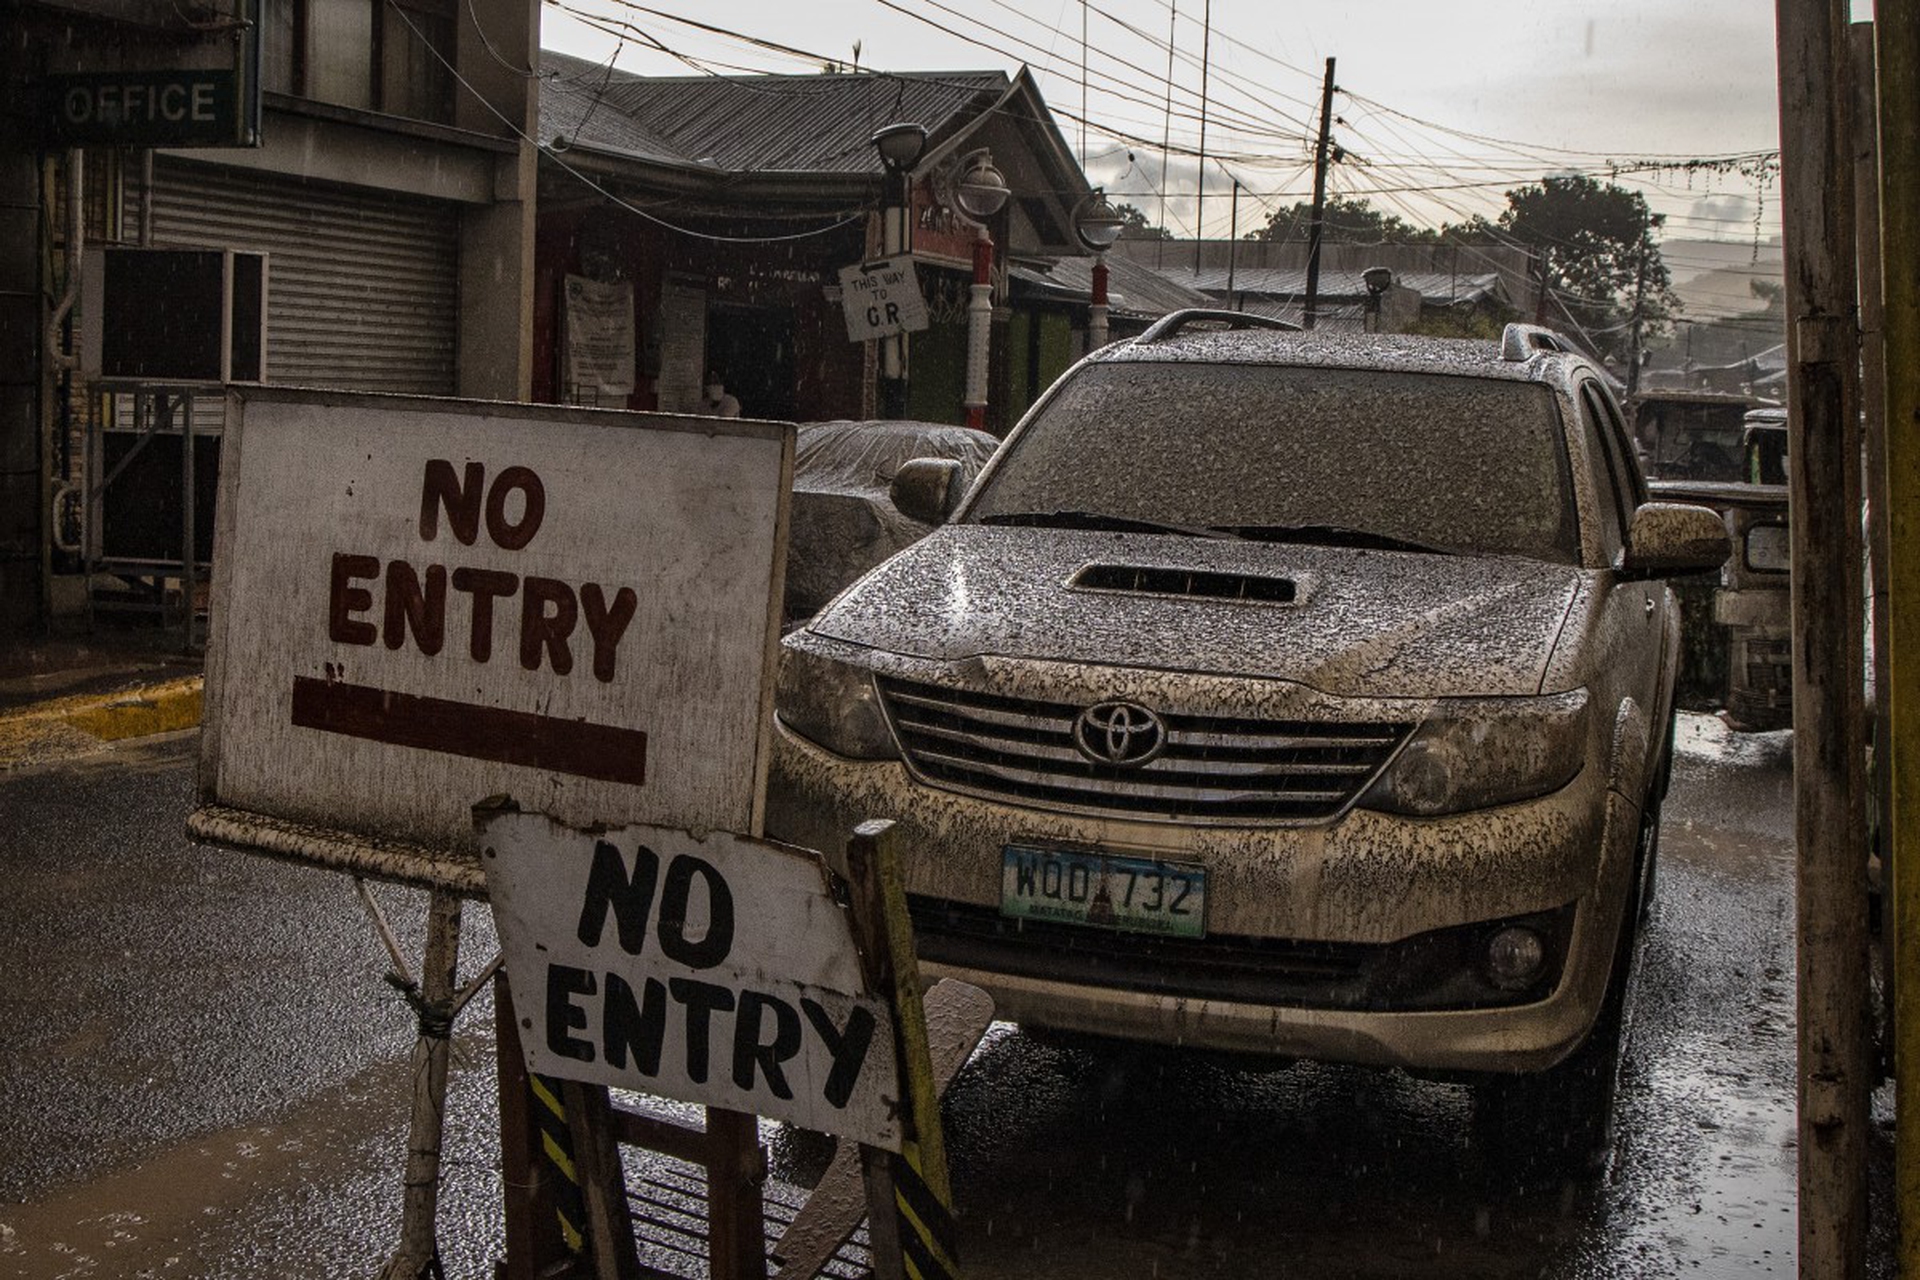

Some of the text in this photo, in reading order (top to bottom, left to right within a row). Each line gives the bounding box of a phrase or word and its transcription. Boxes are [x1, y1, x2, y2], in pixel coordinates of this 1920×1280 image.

[65, 83, 215, 123] OFFICE
[851, 271, 905, 291] THIS WAY
[871, 289, 888, 301] TO
[419, 459, 546, 551] NO
[329, 552, 638, 683] ENTRY
[577, 840, 734, 969] NO
[1116, 866, 1191, 914] 732
[546, 964, 876, 1109] ENTRY
